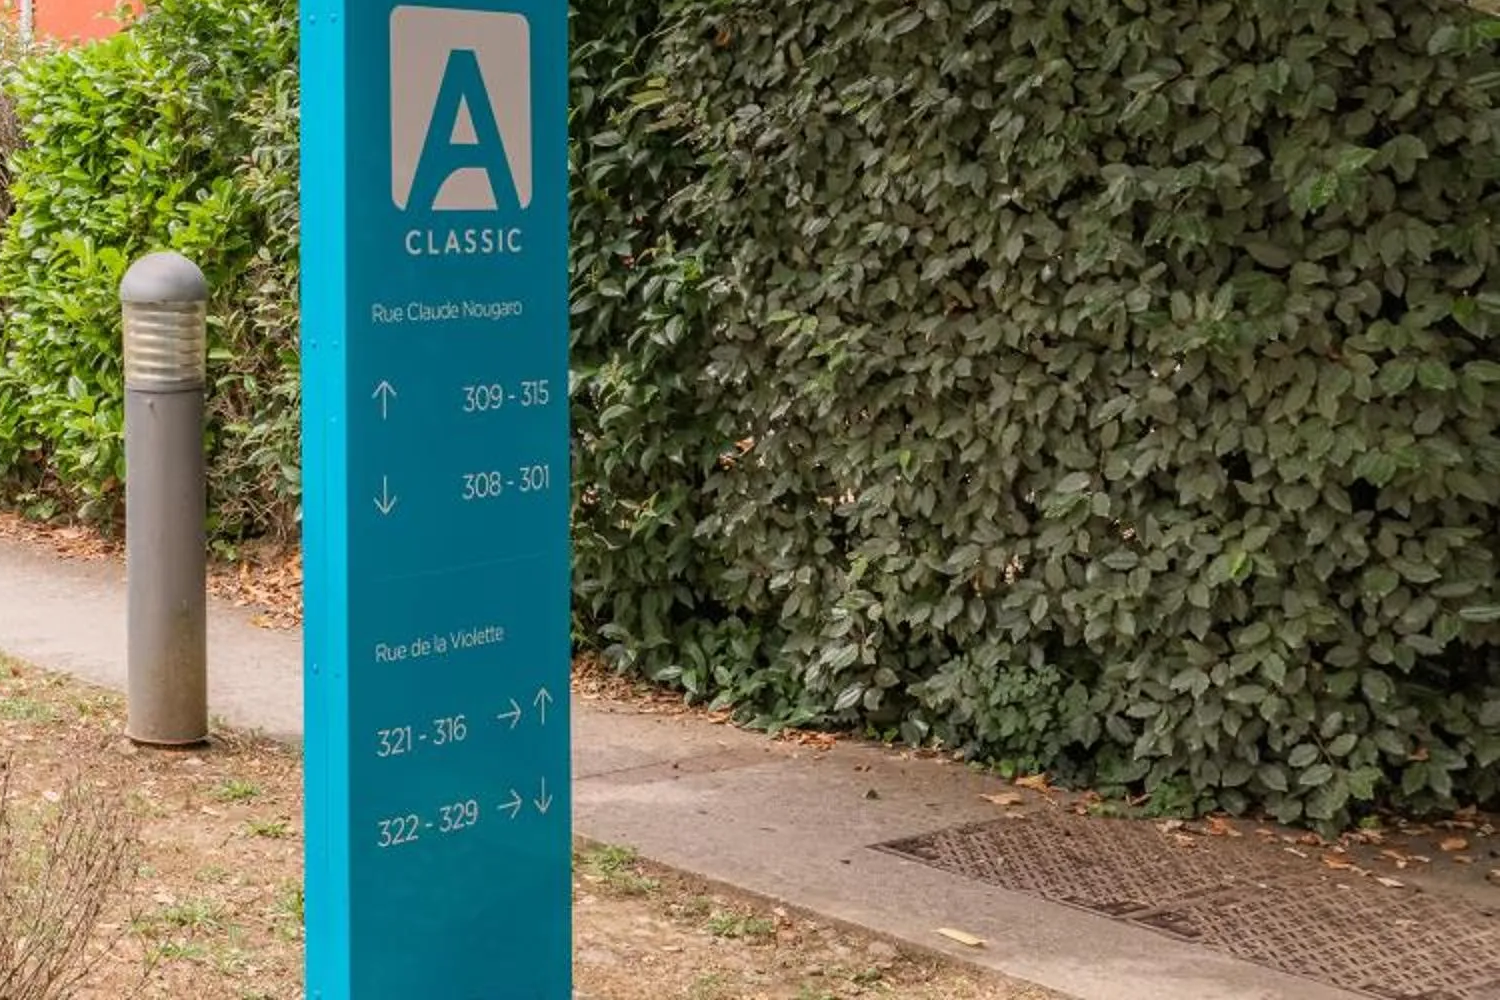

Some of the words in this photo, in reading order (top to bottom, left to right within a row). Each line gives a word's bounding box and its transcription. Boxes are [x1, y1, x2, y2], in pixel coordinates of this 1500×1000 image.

[404, 49, 521, 209] A
[404, 228, 523, 255] CLASSIC
[371, 303, 403, 323] Rue
[407, 301, 459, 321] Claude
[462, 300, 523, 320] Nougaro
[461, 384, 503, 412] 309
[520, 380, 549, 407] 315
[461, 471, 502, 500] 308
[519, 465, 550, 491] 301
[375, 642, 407, 662] Rue
[411, 637, 431, 657] de
[433, 633, 448, 653] la
[450, 625, 505, 649] Violette
[377, 725, 412, 757] 321
[433, 714, 467, 745] 316
[377, 814, 419, 847] 322
[439, 799, 478, 832] 329
